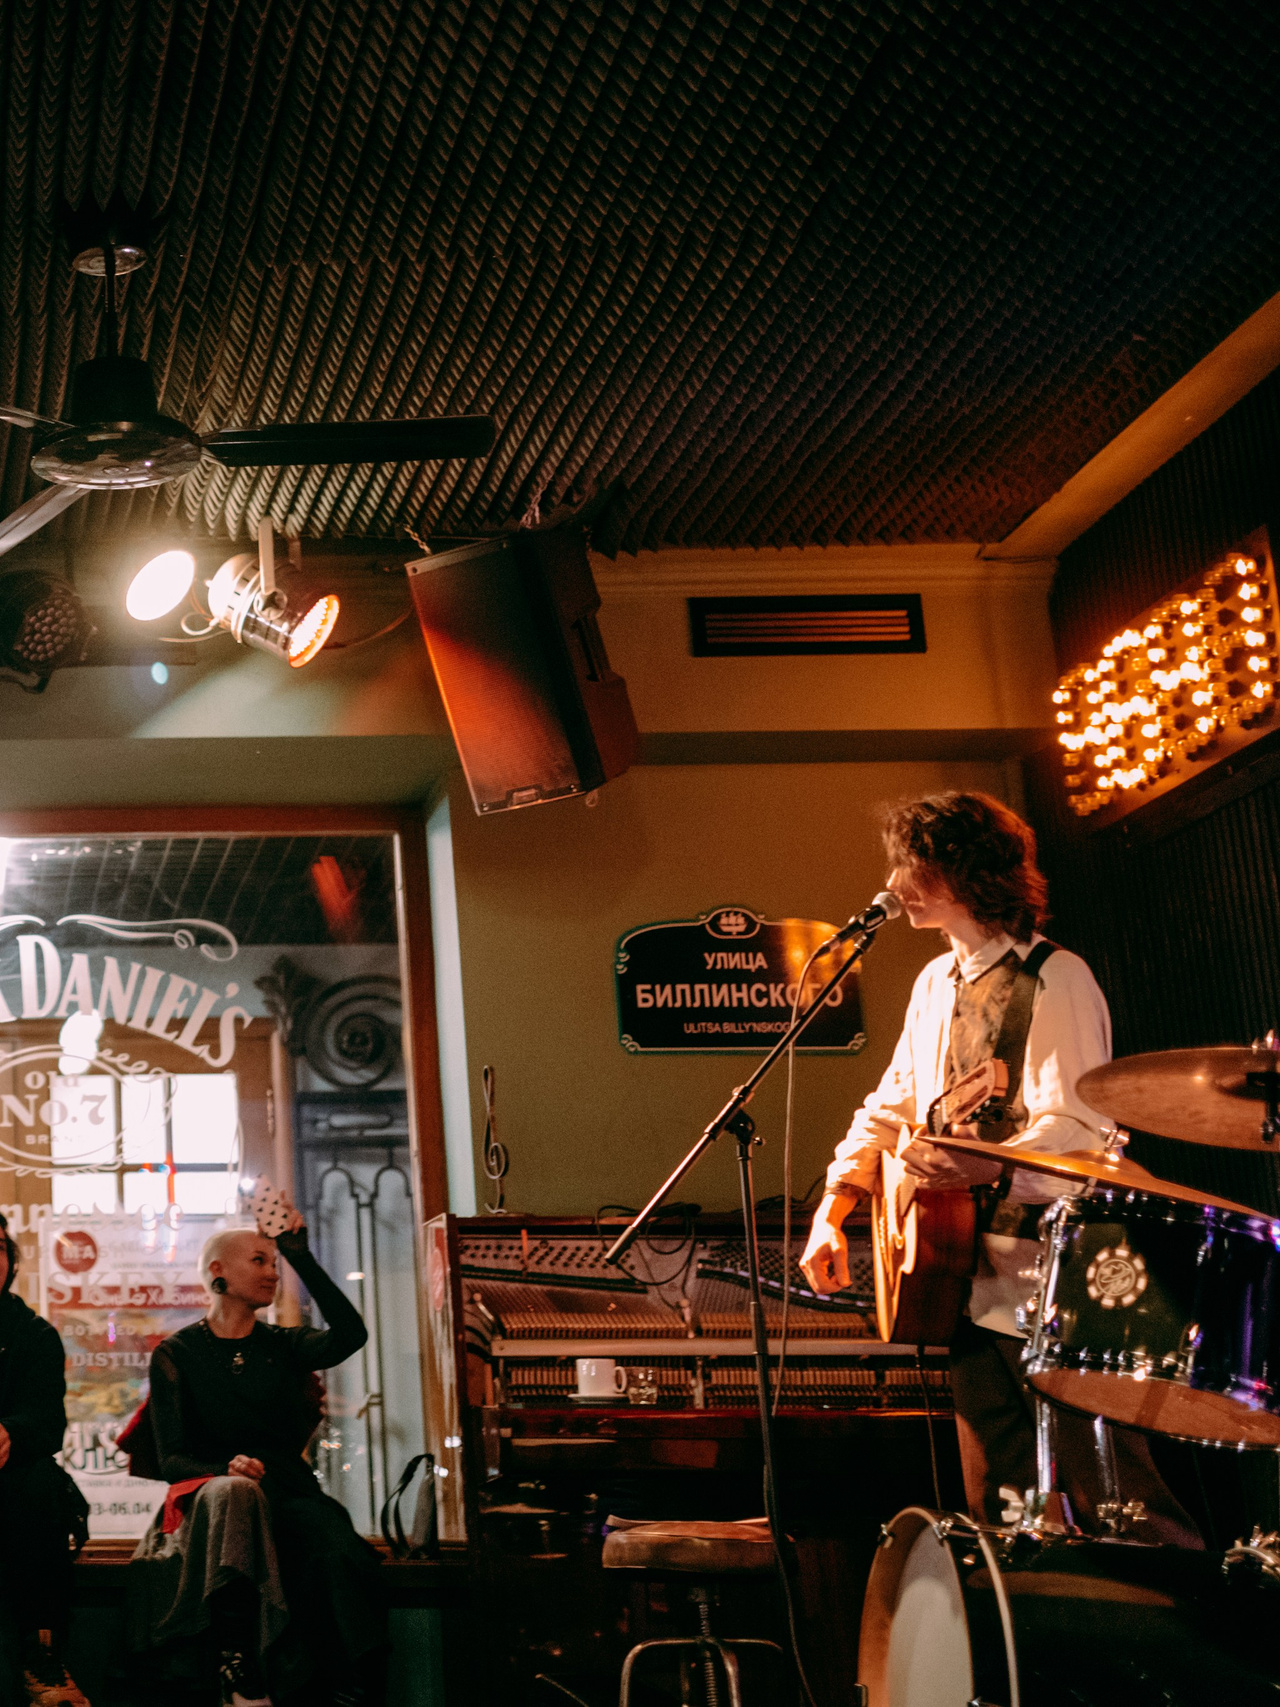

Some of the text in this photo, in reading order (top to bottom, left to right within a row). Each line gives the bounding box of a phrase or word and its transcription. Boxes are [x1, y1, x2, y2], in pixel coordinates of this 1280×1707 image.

[703, 952, 768, 972] УЛИЦА
[16, 934, 254, 1068] DANIEL'S
[636, 983, 843, 1008] БИЛЛИНСКОГО
[683, 1021, 792, 1034] ULITSA BILLYNSKOG
